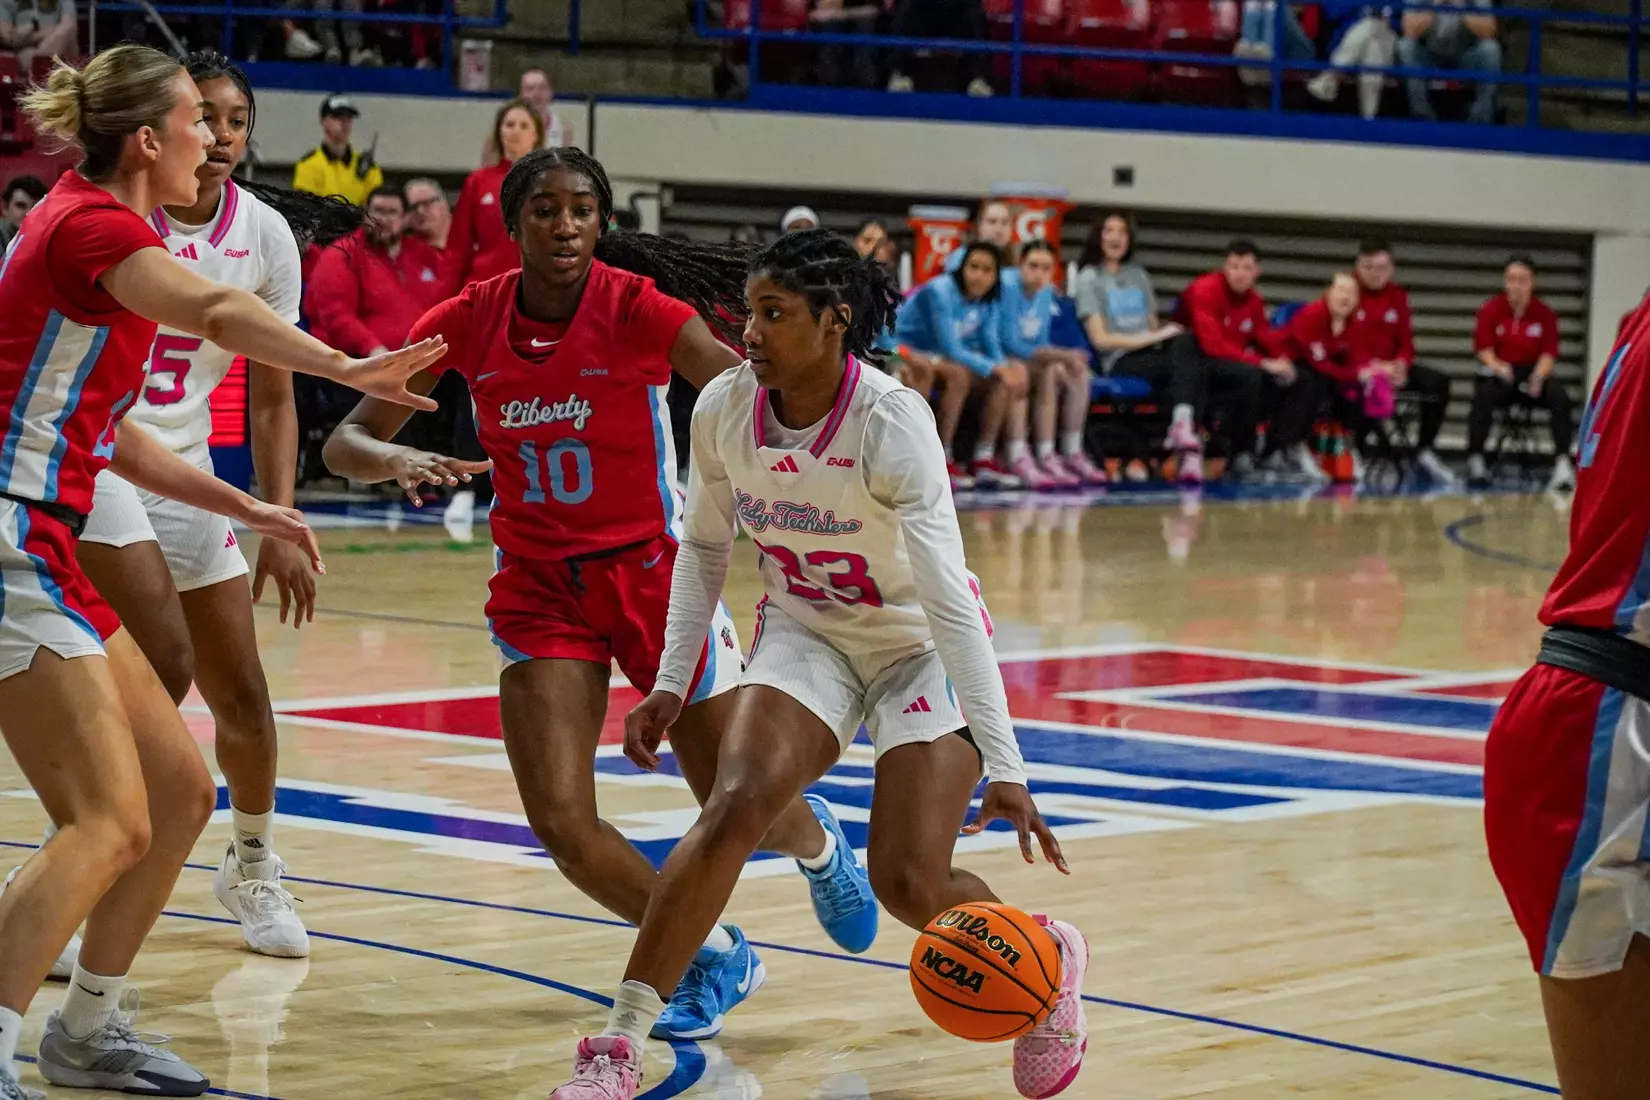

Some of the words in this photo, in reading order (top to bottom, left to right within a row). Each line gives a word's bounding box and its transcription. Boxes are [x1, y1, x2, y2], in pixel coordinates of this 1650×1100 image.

[144, 333, 204, 405] 5
[499, 393, 593, 431] Liberty
[518, 437, 594, 504] 10
[772, 502, 863, 536] Techsters
[753, 539, 883, 608] 23
[935, 909, 1022, 969] Wilson
[920, 945, 986, 994] NCAA
